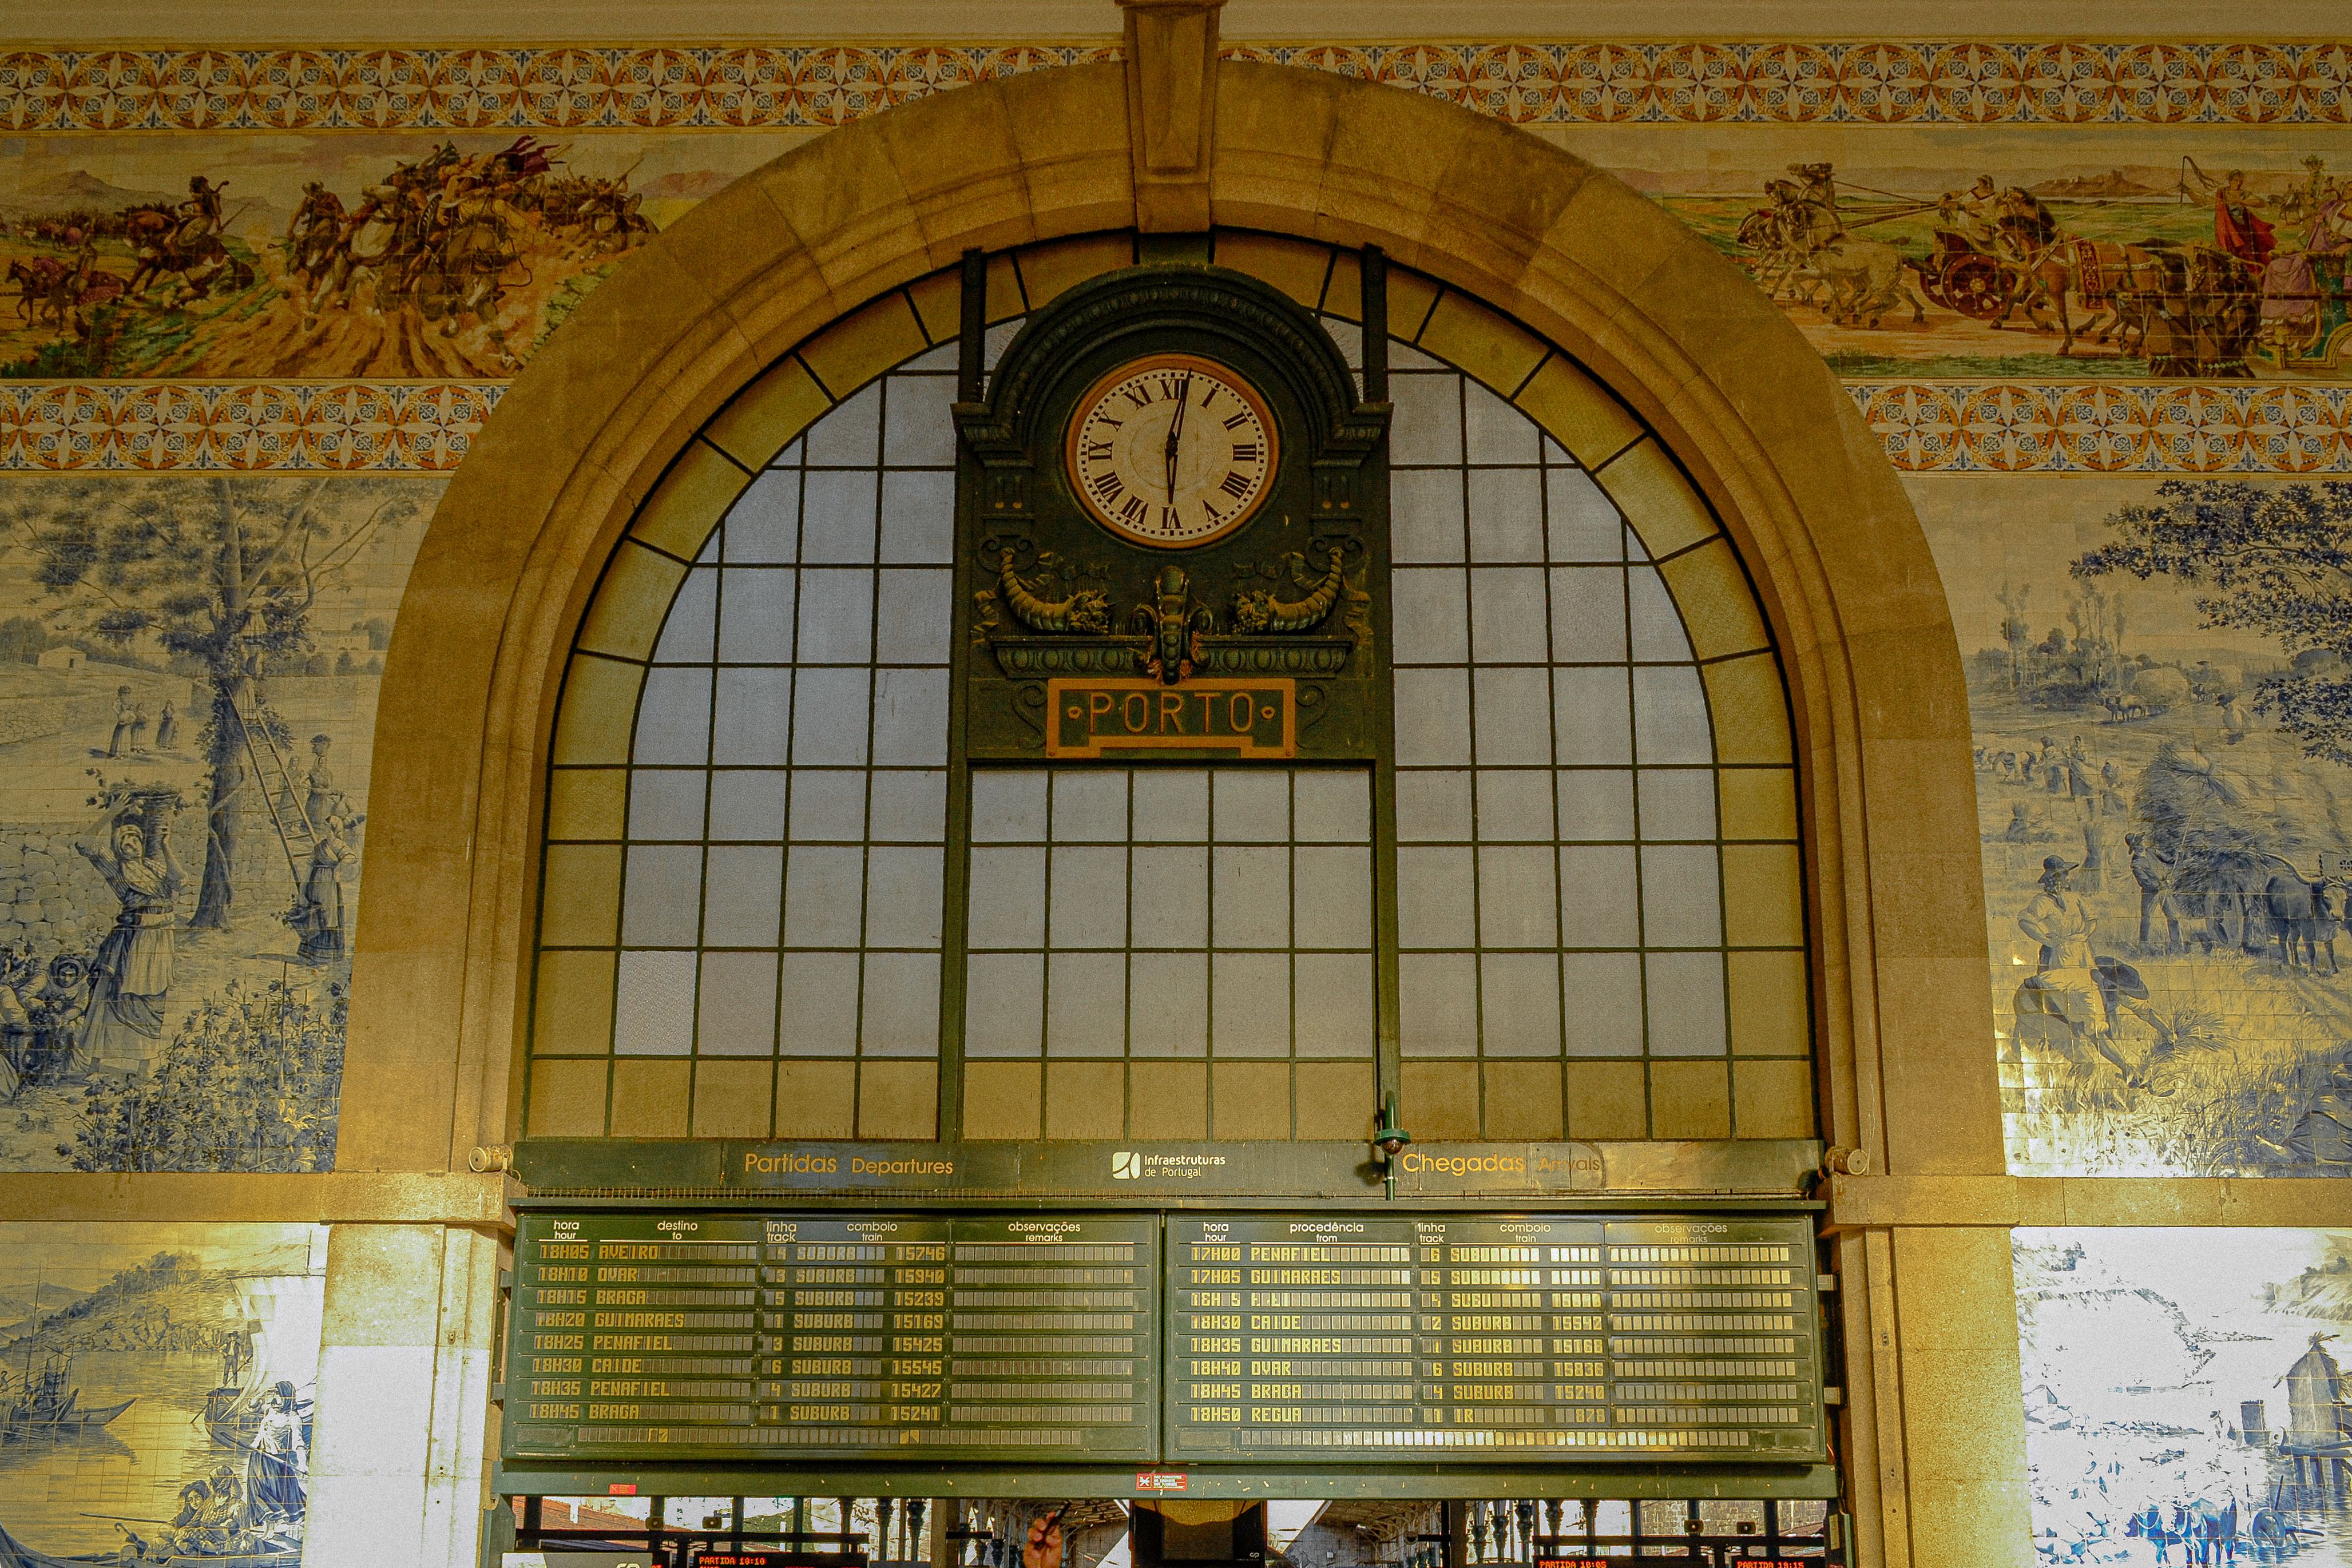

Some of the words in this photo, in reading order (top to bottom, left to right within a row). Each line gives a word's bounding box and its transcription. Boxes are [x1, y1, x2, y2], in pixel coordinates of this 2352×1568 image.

[1089, 692, 1255, 734] PORTO
[745, 1153, 837, 1173] Partidas
[852, 1158, 953, 1176] Departures
[1144, 1155, 1225, 1165] Infraestruturas
[1402, 1153, 1525, 1176] Chegadas
[1538, 1156, 1600, 1172] Arrivals
[1145, 1167, 1156, 1177] de
[1162, 1167, 1201, 1178] Portugal
[553, 1220, 580, 1230] hora
[657, 1220, 698, 1230] destino
[767, 1221, 797, 1232] linha
[847, 1222, 898, 1232] comboio
[1008, 1221, 1081, 1234] observações
[1203, 1222, 1229, 1232] hora
[1290, 1222, 1363, 1234] procedência
[1500, 1223, 1550, 1233] comboio
[1655, 1223, 1728, 1235] observações
[554, 1231, 576, 1239] hour
[672, 1232, 682, 1240] to
[767, 1232, 795, 1241] track
[862, 1233, 883, 1241] train
[1205, 1233, 1227, 1241] hour
[1316, 1234, 1337, 1242] from
[1419, 1234, 1444, 1243] track
[1516, 1234, 1536, 1243] train
[541, 1245, 589, 1259] 18H05
[599, 1245, 658, 1259] AVEIRO
[777, 1247, 787, 1260] 4
[797, 1246, 855, 1260] SUBURB
[897, 1247, 945, 1260] 15746
[1192, 1247, 1240, 1261] 17H00
[1251, 1247, 1330, 1261] PENAFIEL
[540, 1267, 588, 1281] 18H10
[598, 1267, 637, 1281] OVAR
[776, 1269, 786, 1283] 3
[796, 1269, 855, 1283] SUBURB
[896, 1269, 944, 1283] 15940
[1192, 1269, 1240, 1284] 17H05
[1251, 1270, 1340, 1284] GUIMARAES
[1431, 1271, 1440, 1284] 5
[538, 1290, 586, 1304] 18H15
[596, 1291, 645, 1305] BRAGA
[775, 1292, 785, 1305] 5
[795, 1292, 854, 1305] SUBURB
[895, 1292, 944, 1305] 15239
[594, 1313, 684, 1327] GUIMARAES
[775, 1314, 782, 1328] 1
[794, 1314, 854, 1328] SUBURB
[894, 1315, 943, 1328] 15169
[1192, 1315, 1240, 1329] 18H30
[1251, 1315, 1300, 1329] CAIDE
[1432, 1316, 1441, 1330] 2
[1452, 1316, 1511, 1330] SUBURB
[536, 1335, 584, 1349] 18H25
[593, 1336, 673, 1350] PENAFIEL
[774, 1337, 783, 1351] 3
[794, 1337, 852, 1351] SUBURB
[894, 1337, 942, 1352] 15425
[1191, 1338, 1240, 1352] 18H35
[1251, 1338, 1341, 1352] GUIMARAES
[1434, 1339, 1440, 1353] 1
[1453, 1339, 1512, 1353] SUBURB
[534, 1358, 582, 1372] 18H30
[592, 1359, 641, 1372] CAIDE
[772, 1360, 782, 1374] 6
[792, 1360, 852, 1374] SUBURB
[893, 1360, 942, 1375] 15545
[1191, 1361, 1240, 1375] 18H40
[1251, 1361, 1291, 1375] OVAR
[1433, 1363, 1442, 1376] 6
[1453, 1362, 1513, 1376] SUBURB
[532, 1381, 581, 1395] 18H35
[590, 1382, 670, 1396] PENAFIEL
[771, 1383, 781, 1396] 4
[791, 1383, 851, 1397] SUBURB
[892, 1383, 941, 1398] 15427
[1191, 1384, 1240, 1398] 18H45
[1251, 1384, 1302, 1399] BRAGA
[1434, 1386, 1442, 1399] 4
[1454, 1386, 1513, 1399] SUBURB
[530, 1404, 580, 1418] 18H45
[589, 1404, 639, 1419] BRAGA
[770, 1406, 778, 1420] 1
[790, 1406, 850, 1420] SUBURB
[891, 1406, 940, 1420] 15241
[1191, 1407, 1240, 1422] 18H50
[1251, 1407, 1302, 1422] REGUA
[1434, 1408, 1442, 1422] 1
[1455, 1408, 1474, 1423] IR
[1576, 1408, 1605, 1423] 878
[699, 1557, 735, 1565] PARTIDA
